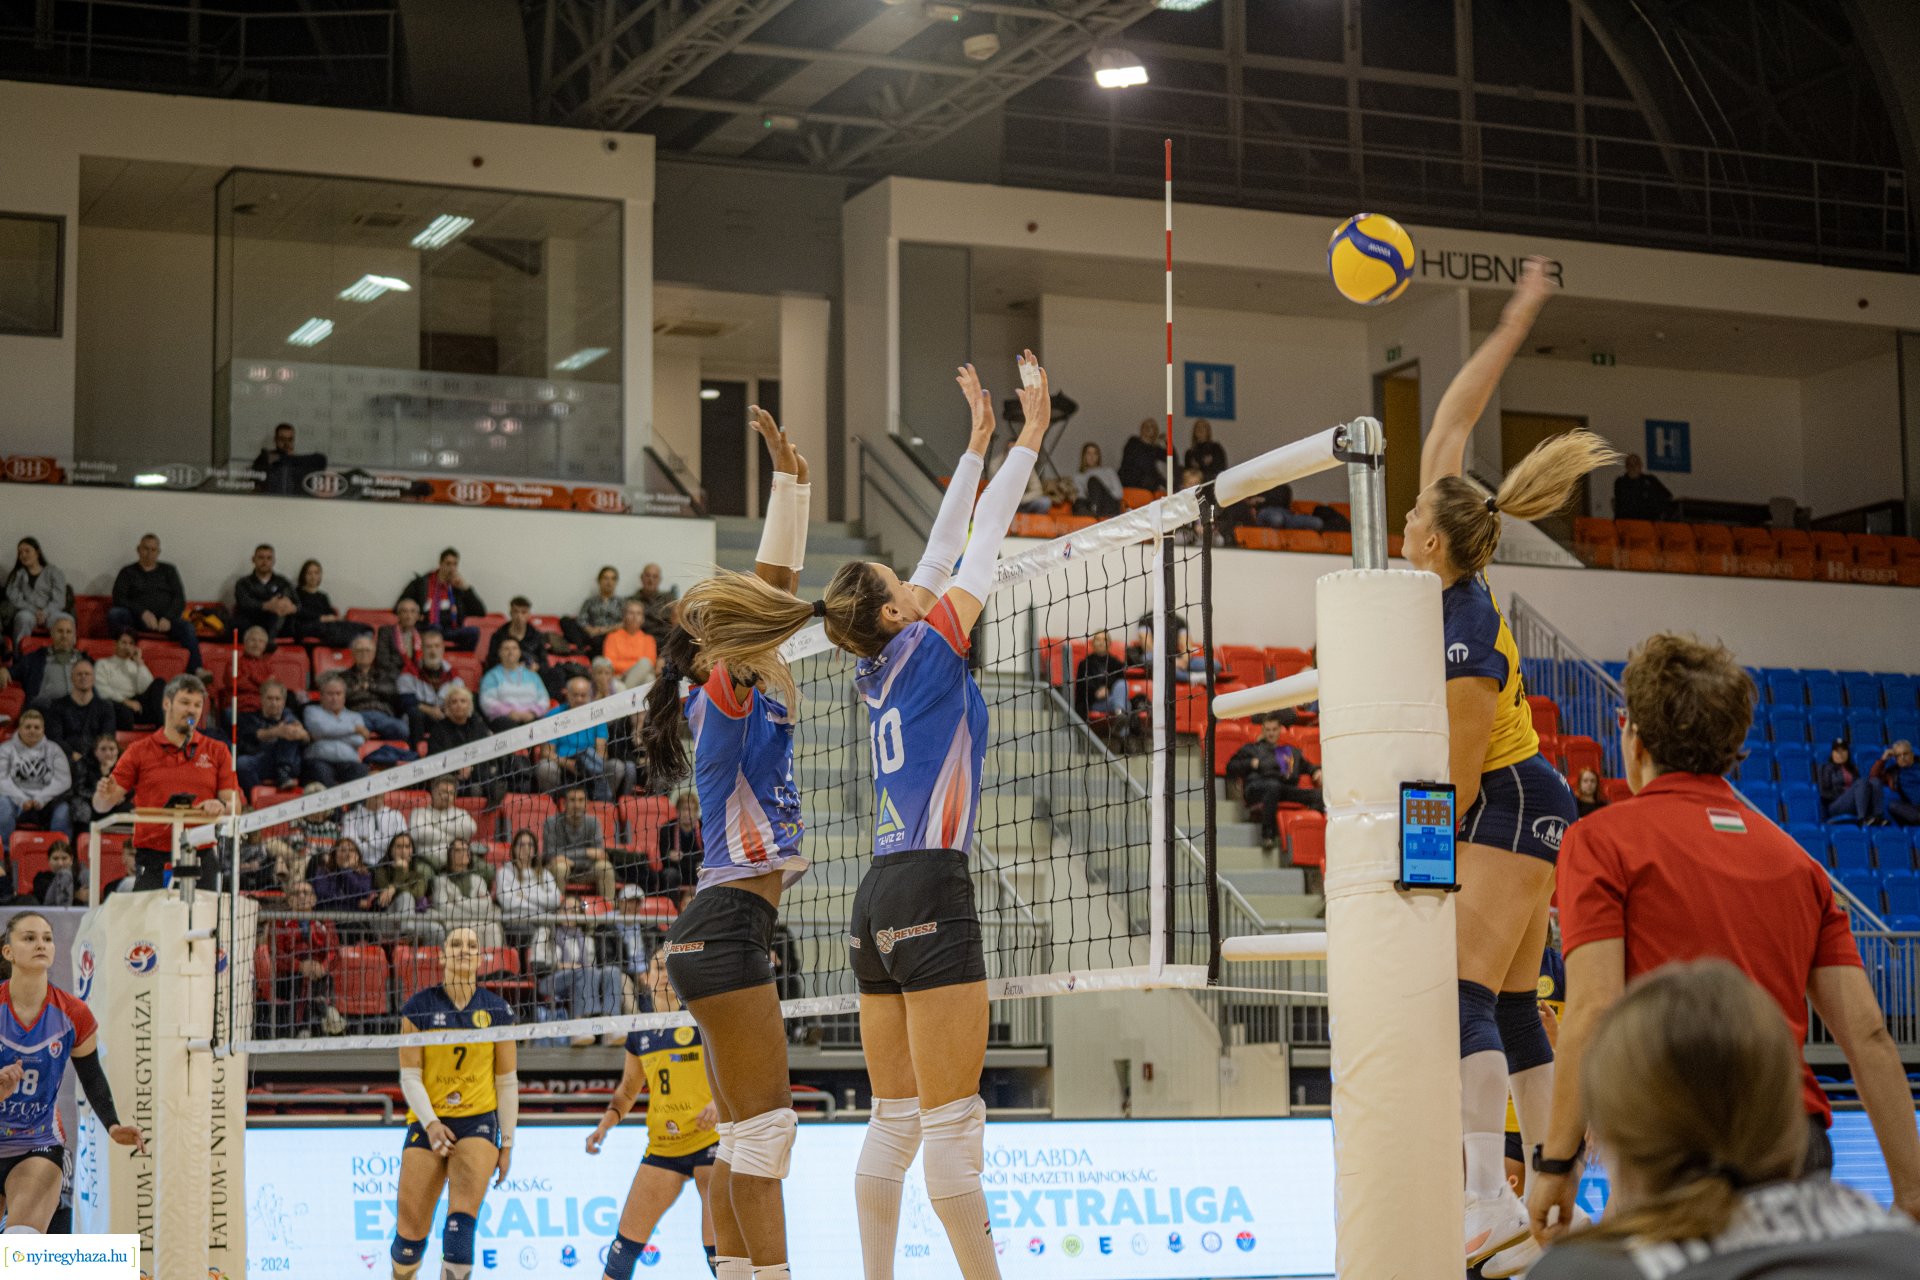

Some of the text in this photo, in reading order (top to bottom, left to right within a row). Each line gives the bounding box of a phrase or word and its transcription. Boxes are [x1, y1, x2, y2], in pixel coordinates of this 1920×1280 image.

[870, 707, 905, 781] 10
[892, 923, 937, 940] REVESZ
[671, 942, 704, 953] REVESZ
[453, 1046, 467, 1071] 7
[658, 1069, 671, 1096] 8
[1014, 1169, 1074, 1185] NEMZETI
[1079, 1168, 1158, 1185] BAJNOKSÁG
[986, 1185, 1255, 1229] EXTRALIGA
[904, 1244, 930, 1258] 2024
[261, 1257, 290, 1272] 2024
